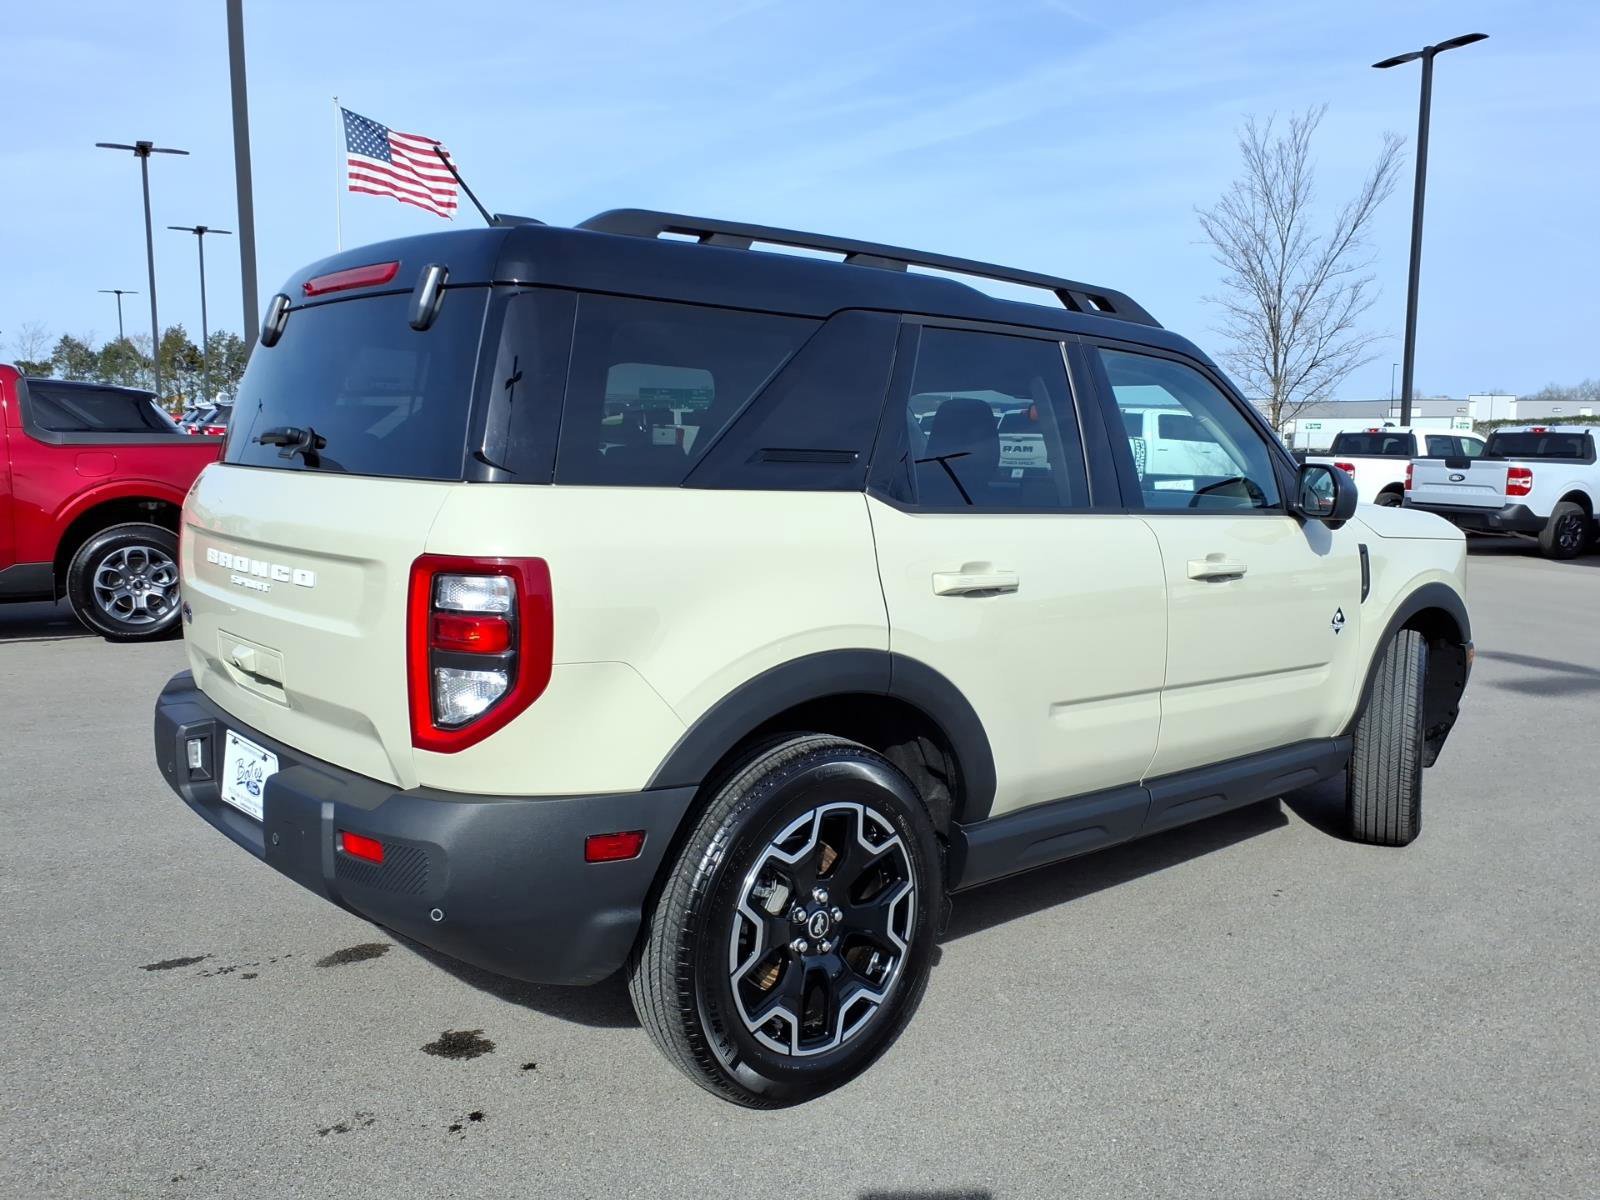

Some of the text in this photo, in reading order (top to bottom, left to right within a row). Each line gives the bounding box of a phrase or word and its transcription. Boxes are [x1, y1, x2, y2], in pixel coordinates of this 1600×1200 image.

[1002, 445, 1034, 453] RAM
[207, 547, 316, 588] BRONCO
[230, 574, 272, 592] SPORT
